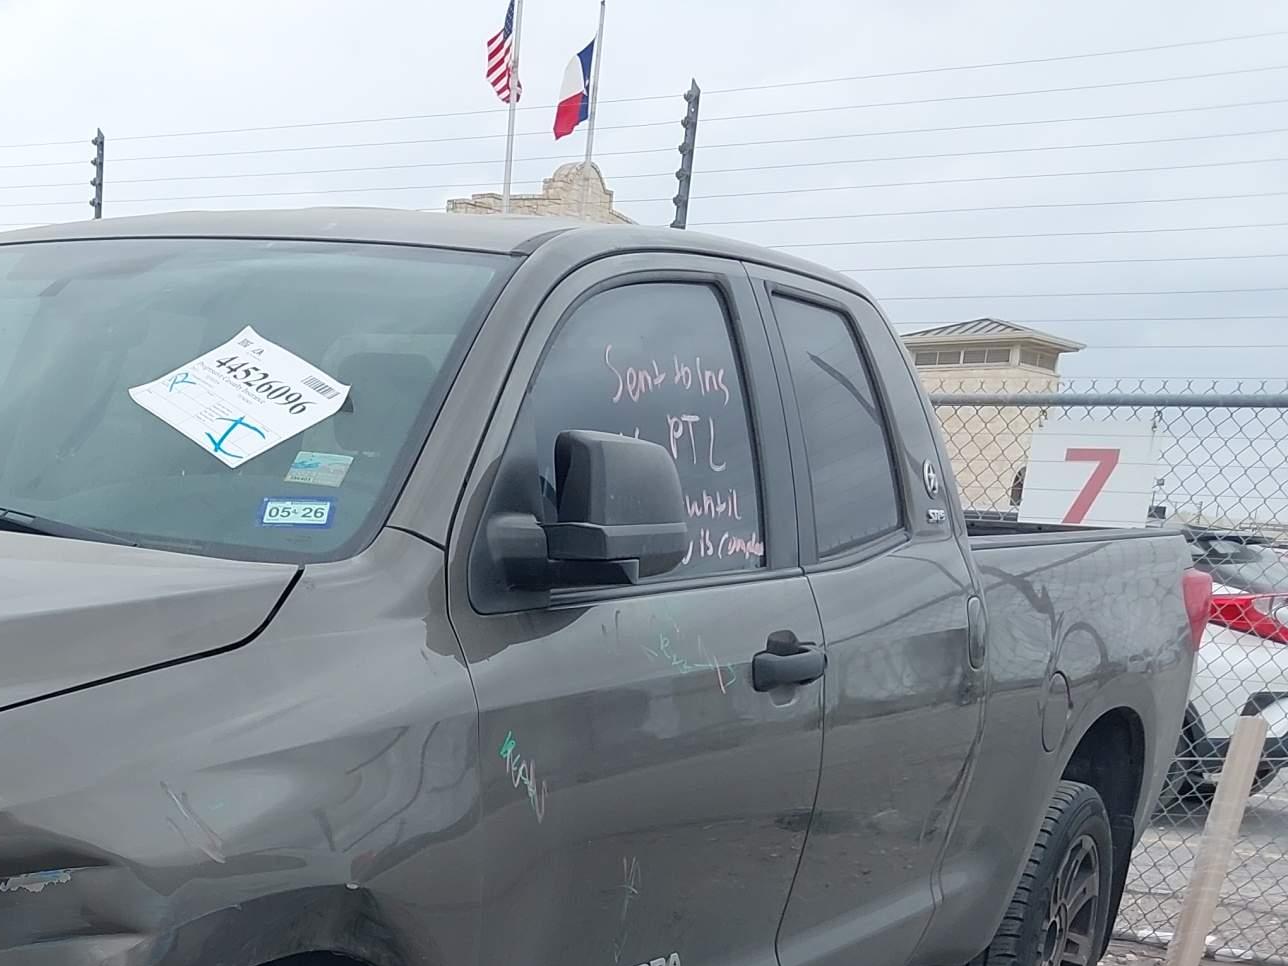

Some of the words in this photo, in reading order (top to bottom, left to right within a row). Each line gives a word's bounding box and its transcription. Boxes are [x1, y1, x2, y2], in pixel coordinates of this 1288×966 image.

[216, 355, 315, 415] 44526096
[605, 344, 666, 403] Sent
[673, 354, 692, 390] to
[267, 506, 292, 519] 05
[300, 507, 325, 519] 26
[1061, 447, 1121, 525] 7
